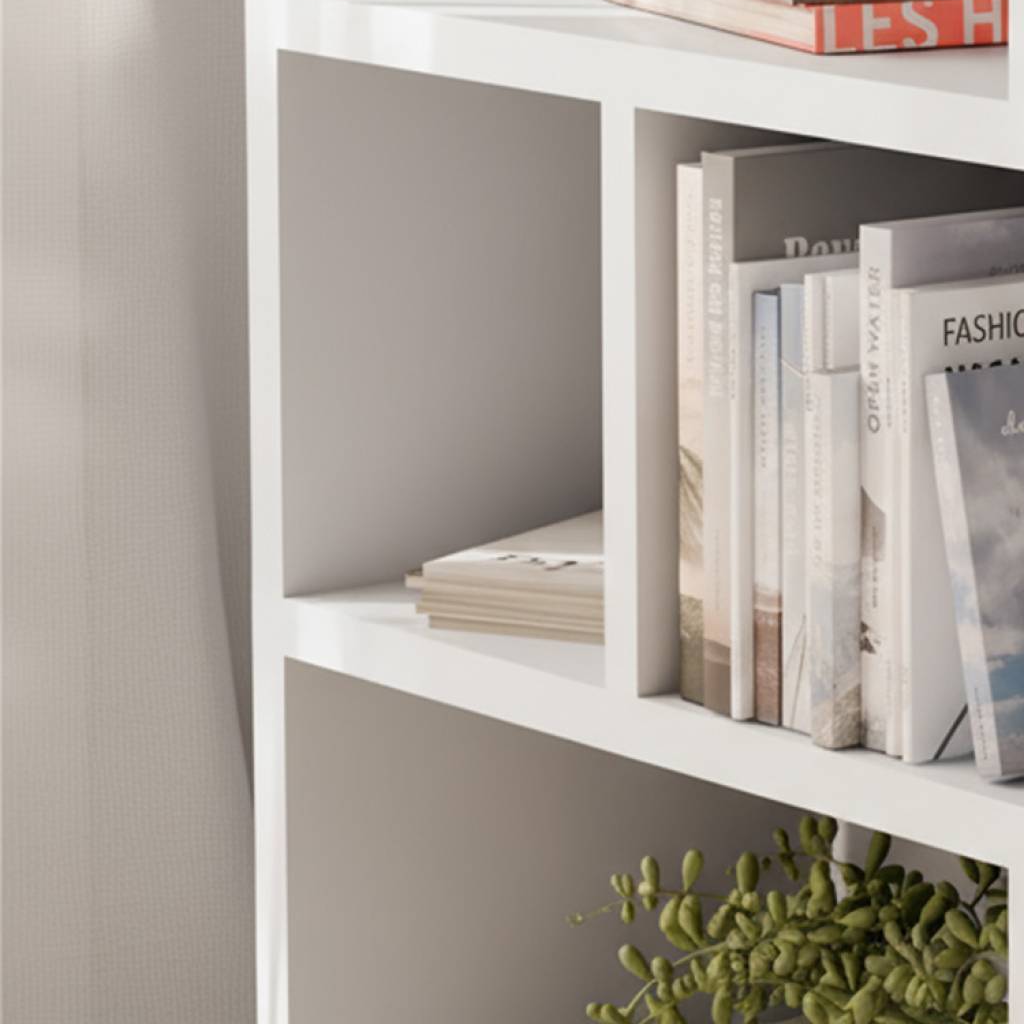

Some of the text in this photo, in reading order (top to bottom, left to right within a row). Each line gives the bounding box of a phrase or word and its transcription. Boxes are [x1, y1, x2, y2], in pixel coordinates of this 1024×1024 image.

[823, 1, 940, 53] LES
[867, 265, 881, 434] OPEN WATER
